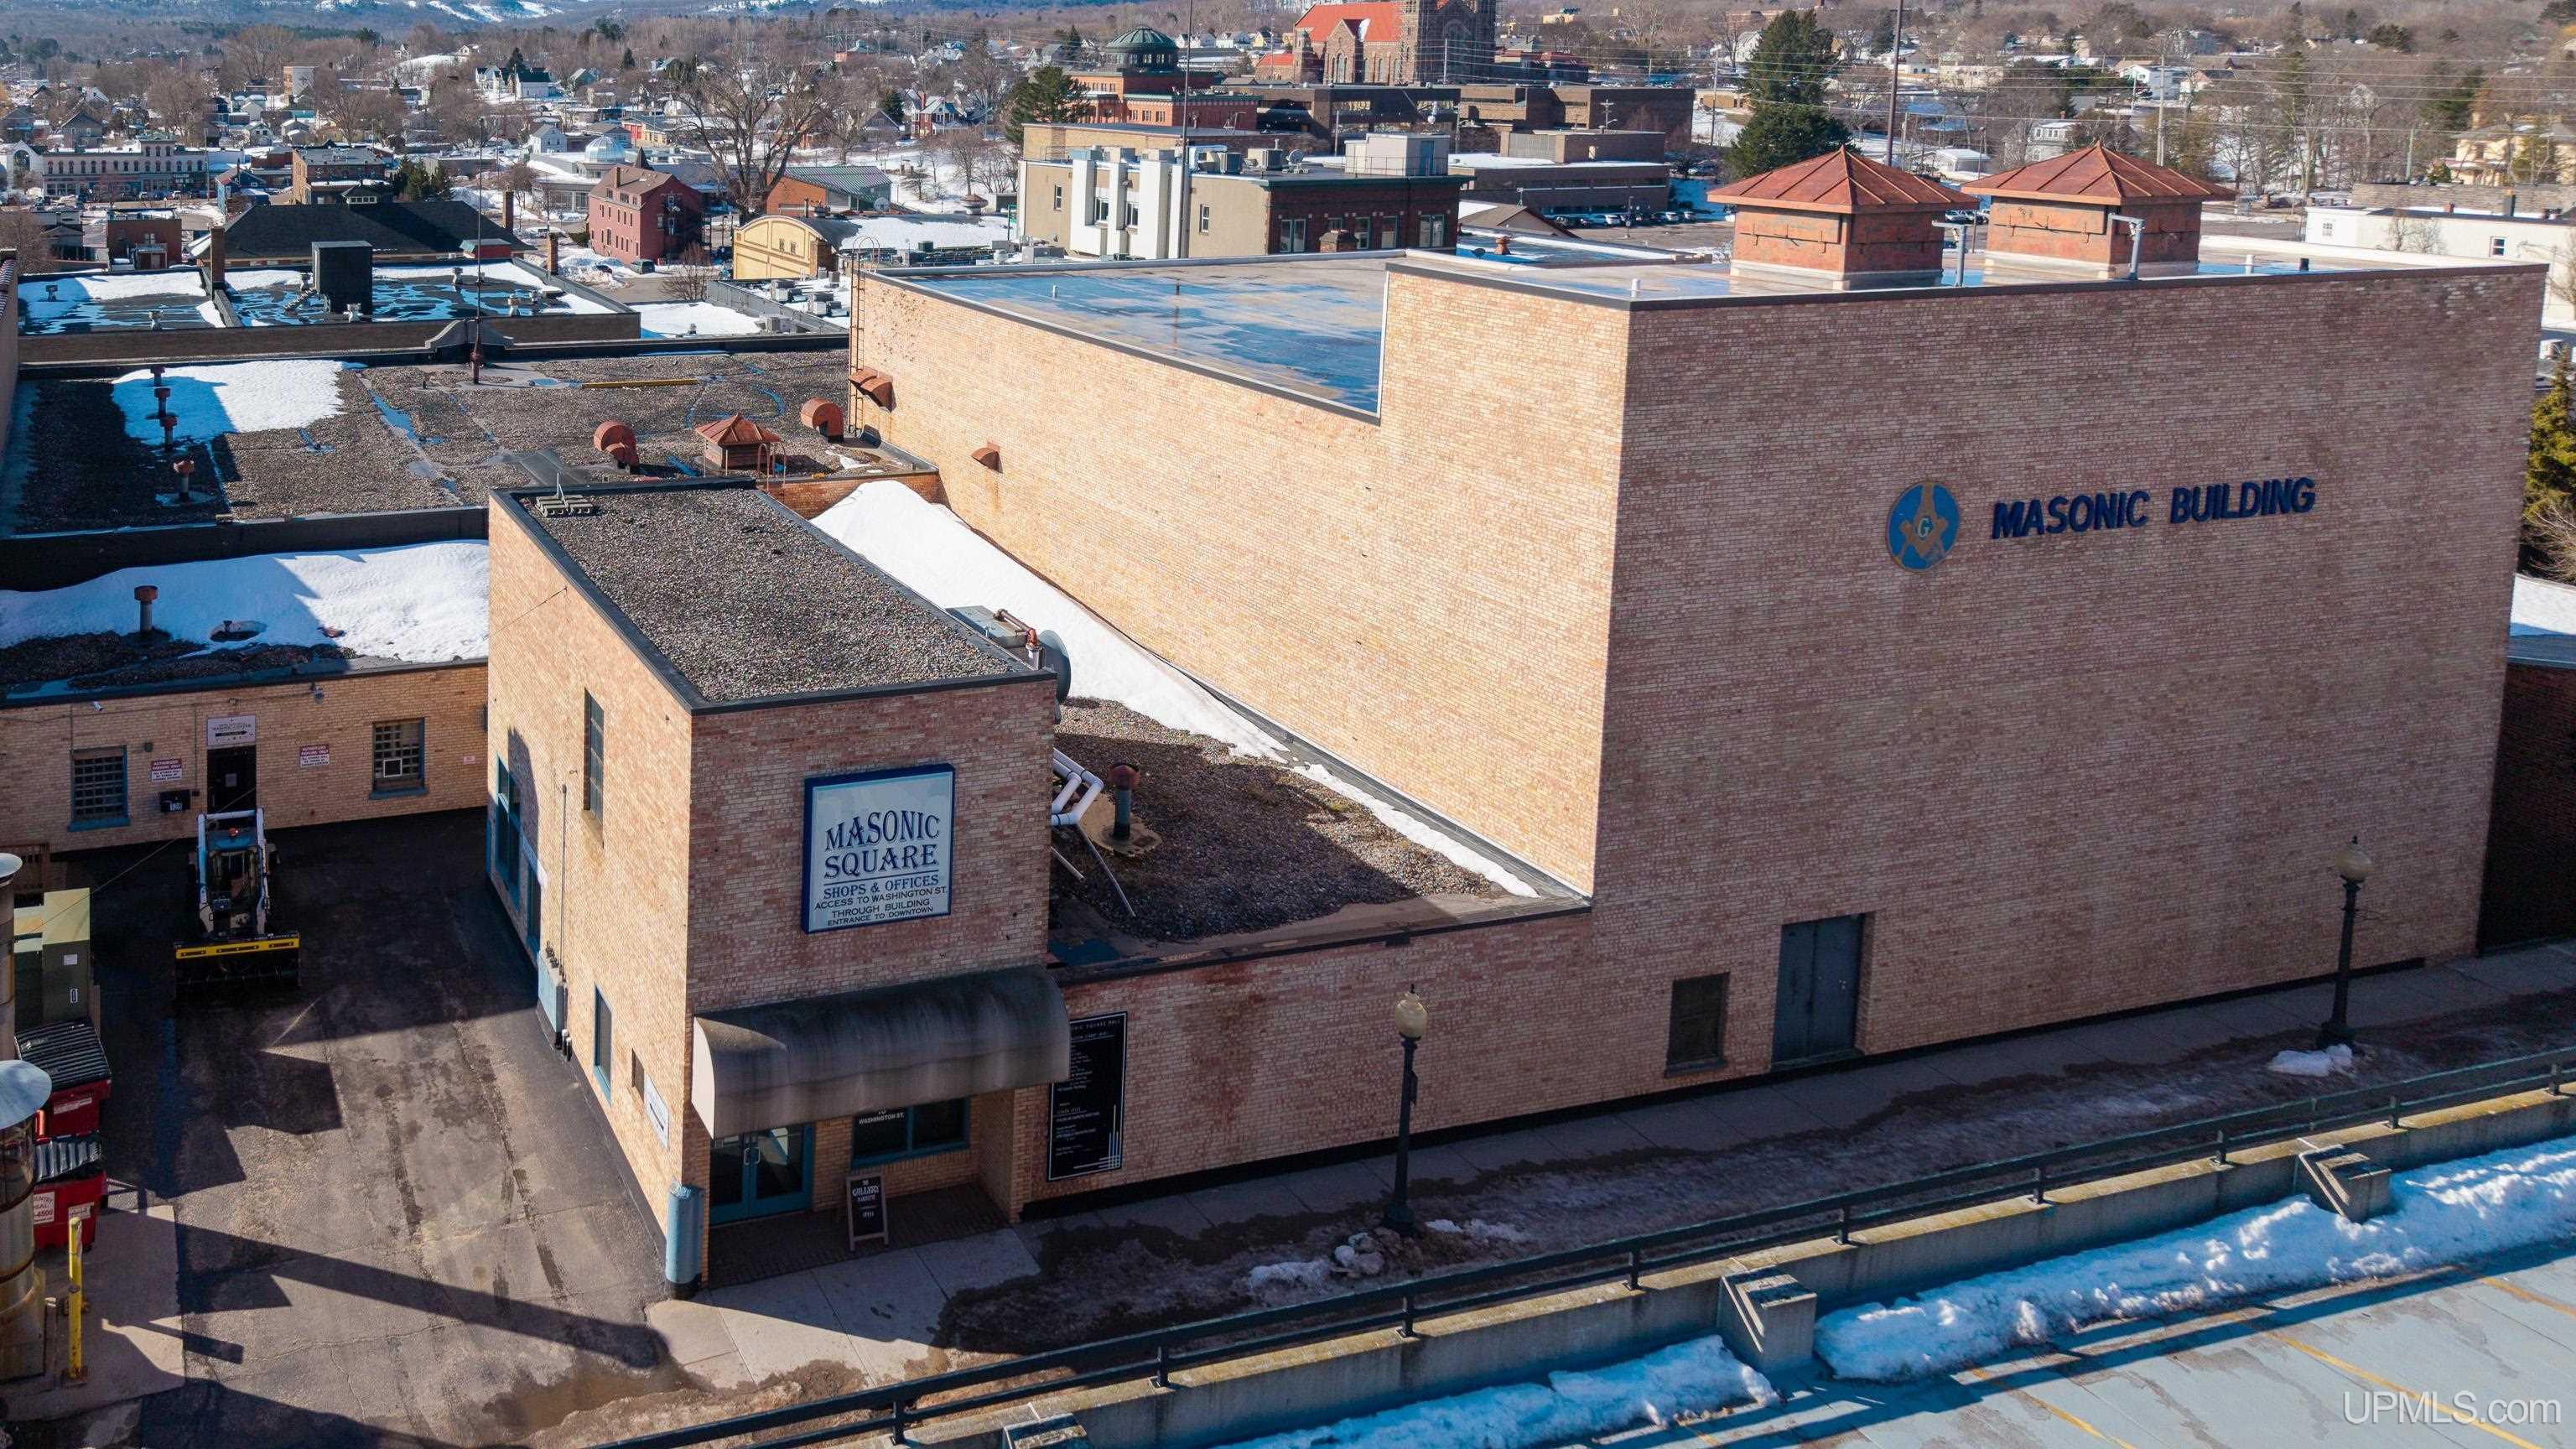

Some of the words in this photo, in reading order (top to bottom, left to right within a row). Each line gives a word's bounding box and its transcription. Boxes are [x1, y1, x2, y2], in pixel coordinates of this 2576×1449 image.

[1992, 490, 2150, 539] MASONIC
[2169, 477, 2316, 524] BUILDING
[825, 810, 940, 852] MASONIC
[824, 844, 939, 879] SQUARE
[823, 884, 866, 900] SHOPS
[870, 882, 880, 893] &
[886, 875, 939, 891] OFFICES
[814, 898, 854, 910] ACCESS
[871, 889, 933, 902] WASHINGTON
[832, 906, 880, 918] THROUGH
[885, 898, 930, 911] BUILDING
[828, 915, 871, 926] ENTRANCE
[889, 906, 933, 918] DOWNTOWN
[859, 1114, 896, 1124] WASHINGTON
